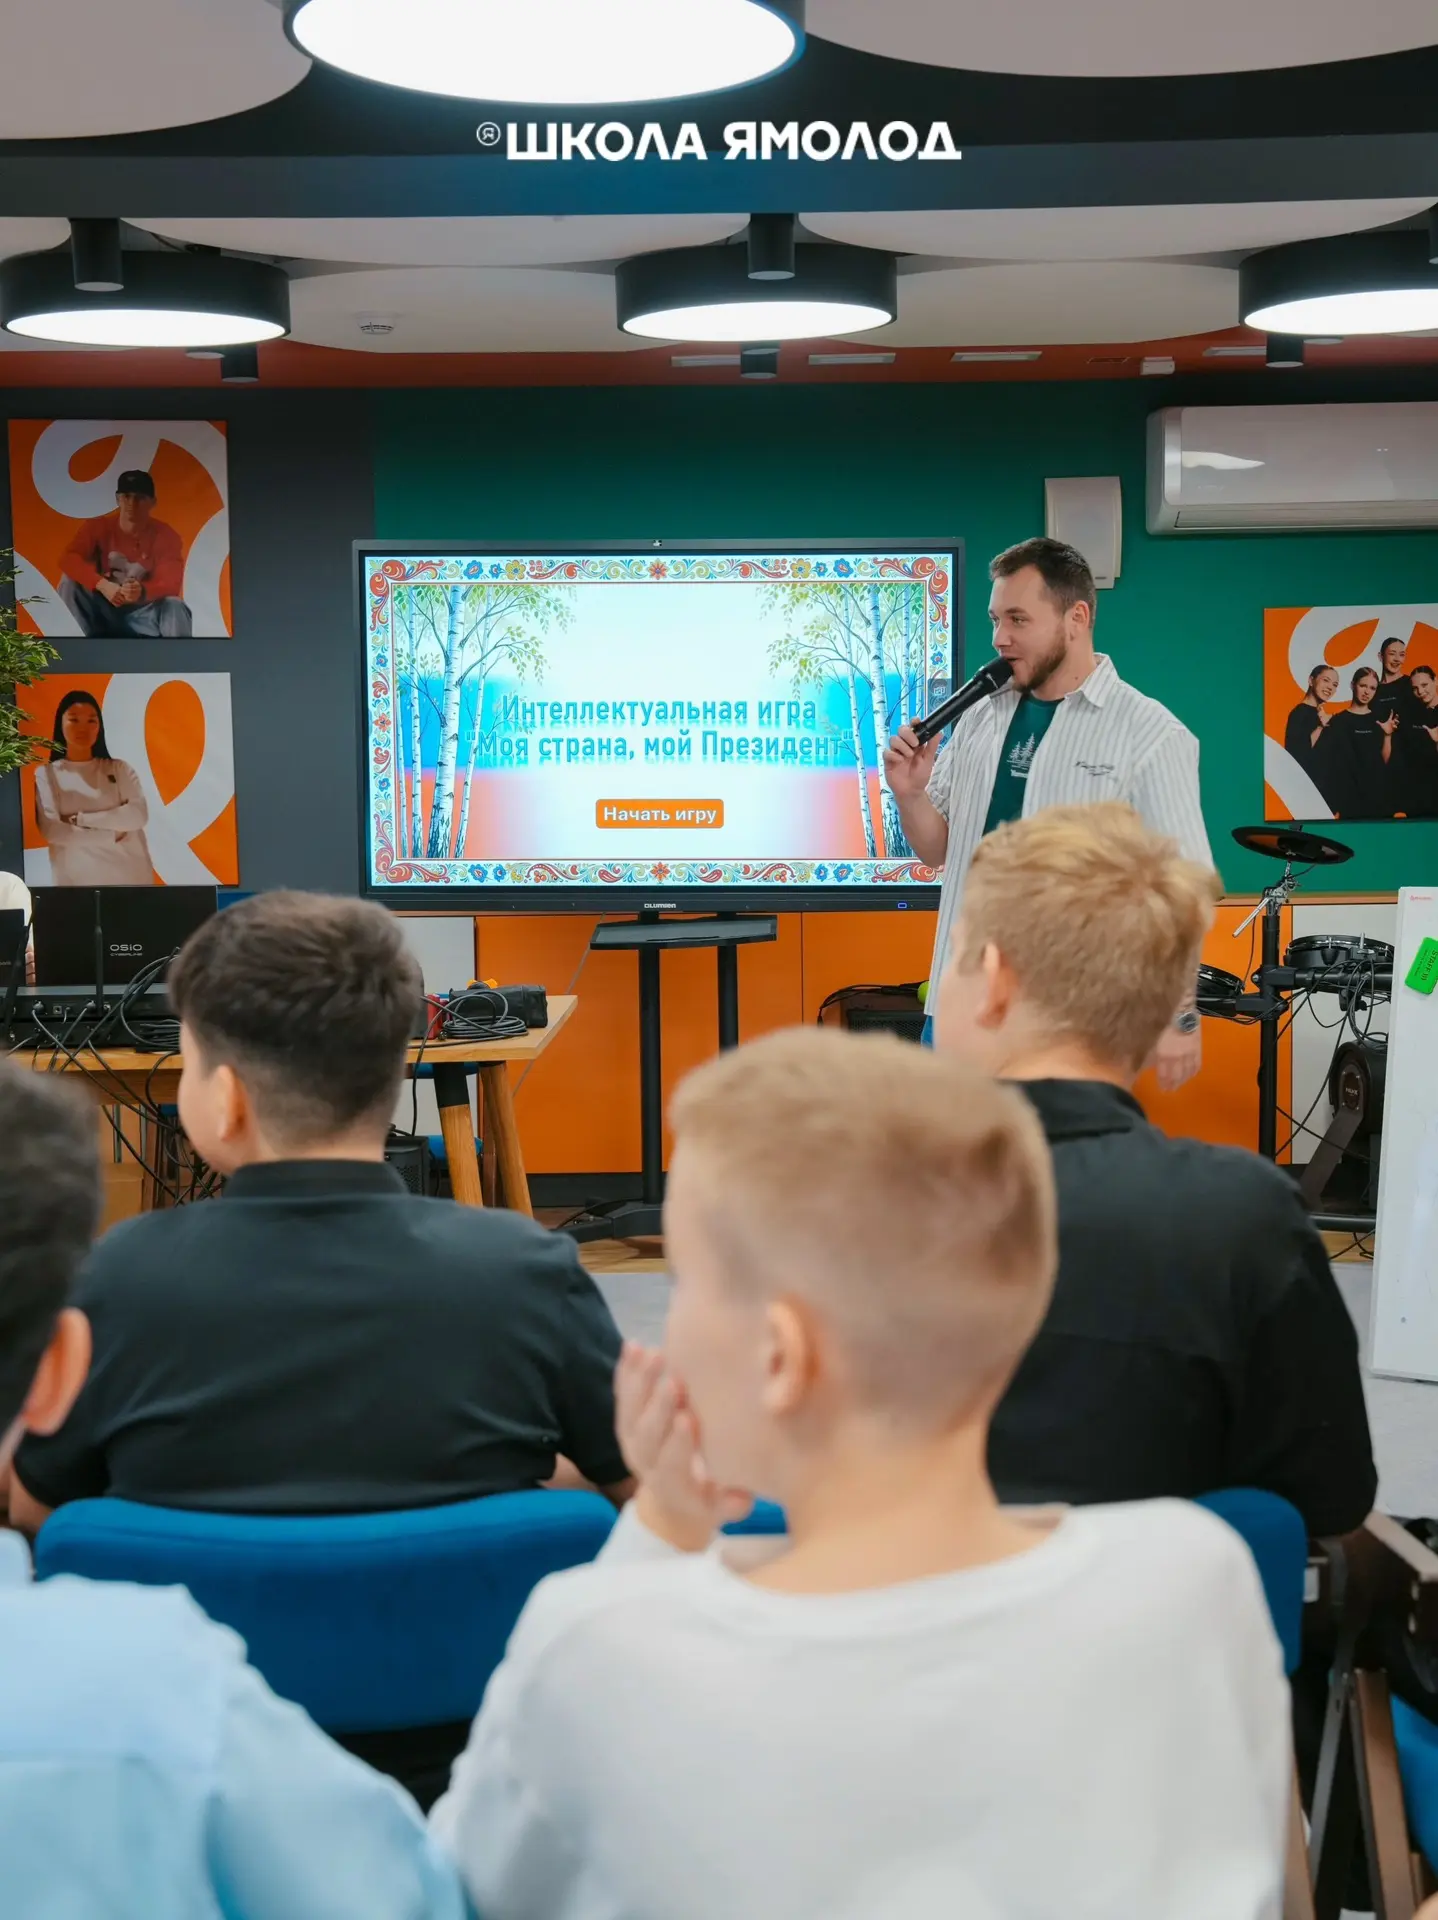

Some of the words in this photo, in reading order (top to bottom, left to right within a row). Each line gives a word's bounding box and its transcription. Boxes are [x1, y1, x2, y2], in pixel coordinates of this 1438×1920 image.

[502, 695, 748, 727] Интеллектуальная
[758, 700, 817, 726] игра
[538, 736, 635, 763] страна,
[644, 728, 692, 756] мой
[603, 806, 671, 821] Начать
[675, 809, 717, 824] игру
